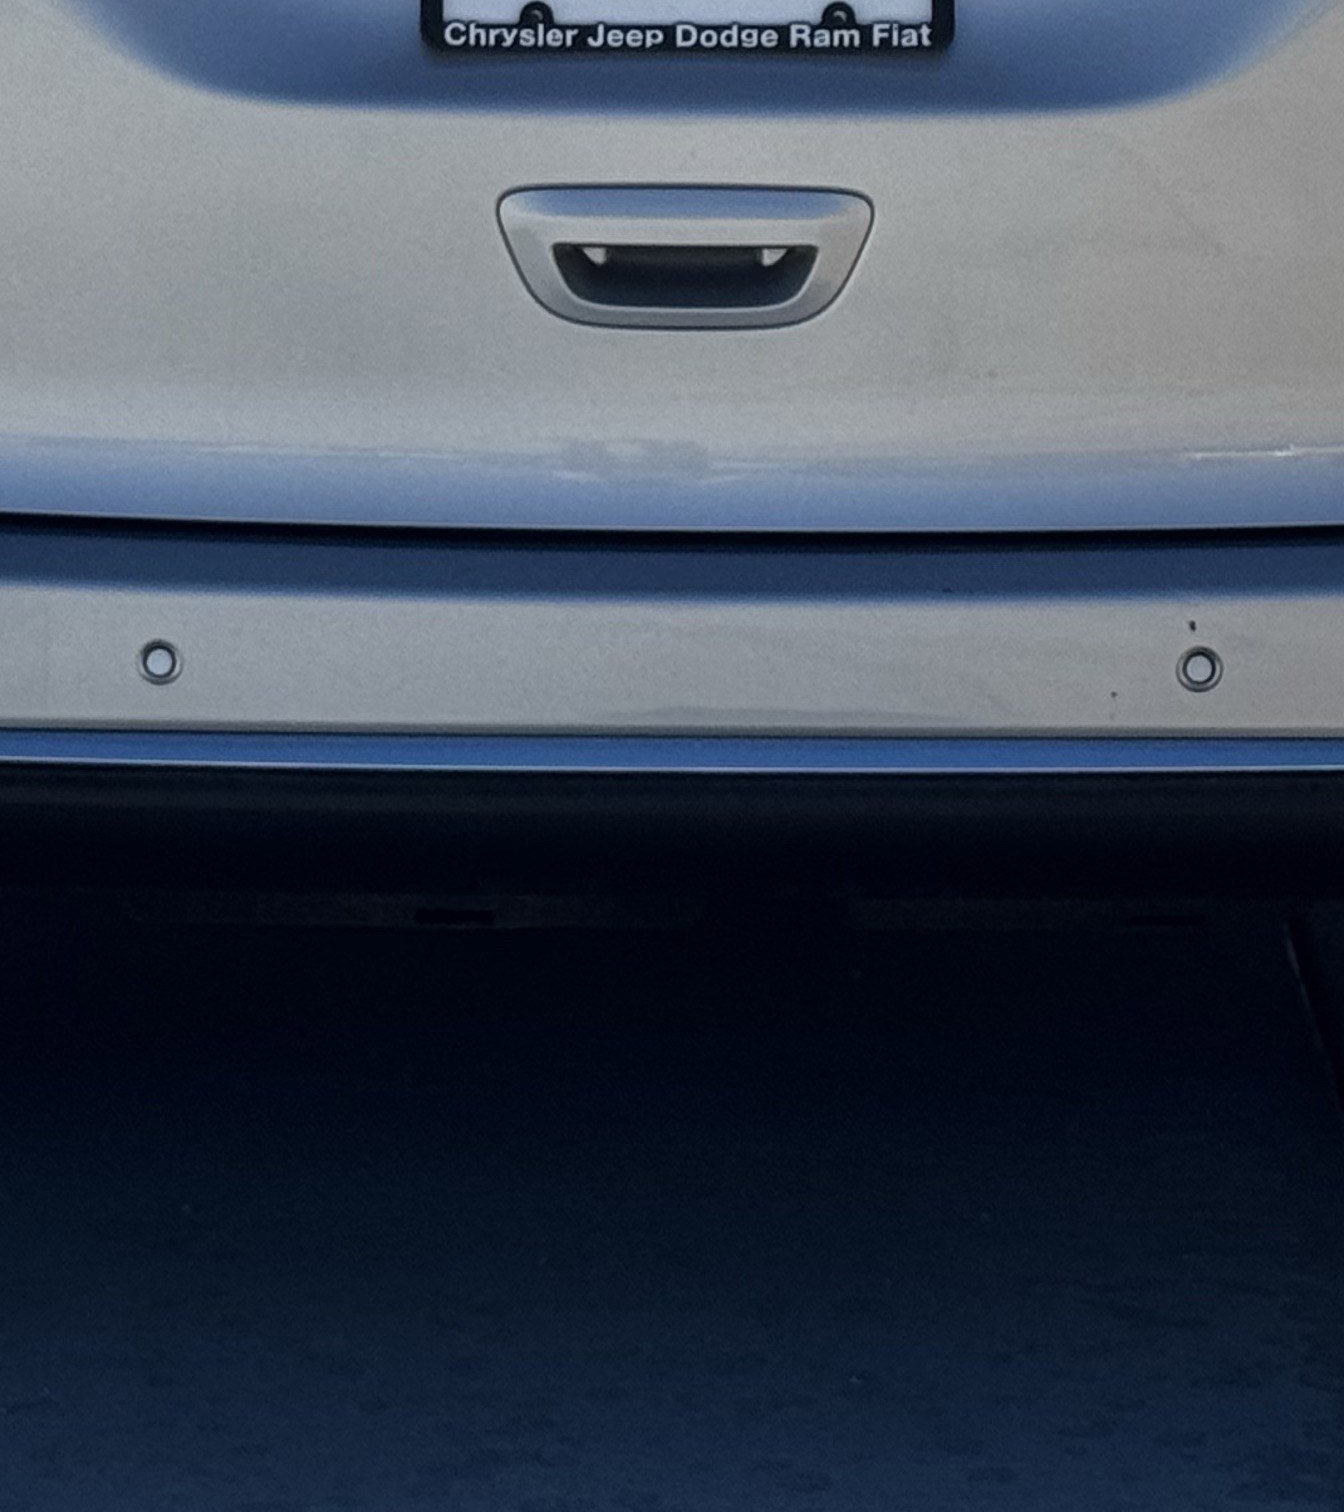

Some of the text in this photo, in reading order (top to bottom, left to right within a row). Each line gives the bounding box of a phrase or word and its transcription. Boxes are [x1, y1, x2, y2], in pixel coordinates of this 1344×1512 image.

[443, 22, 933, 51] Chrysler Jeep Dodge Ram Fiat
